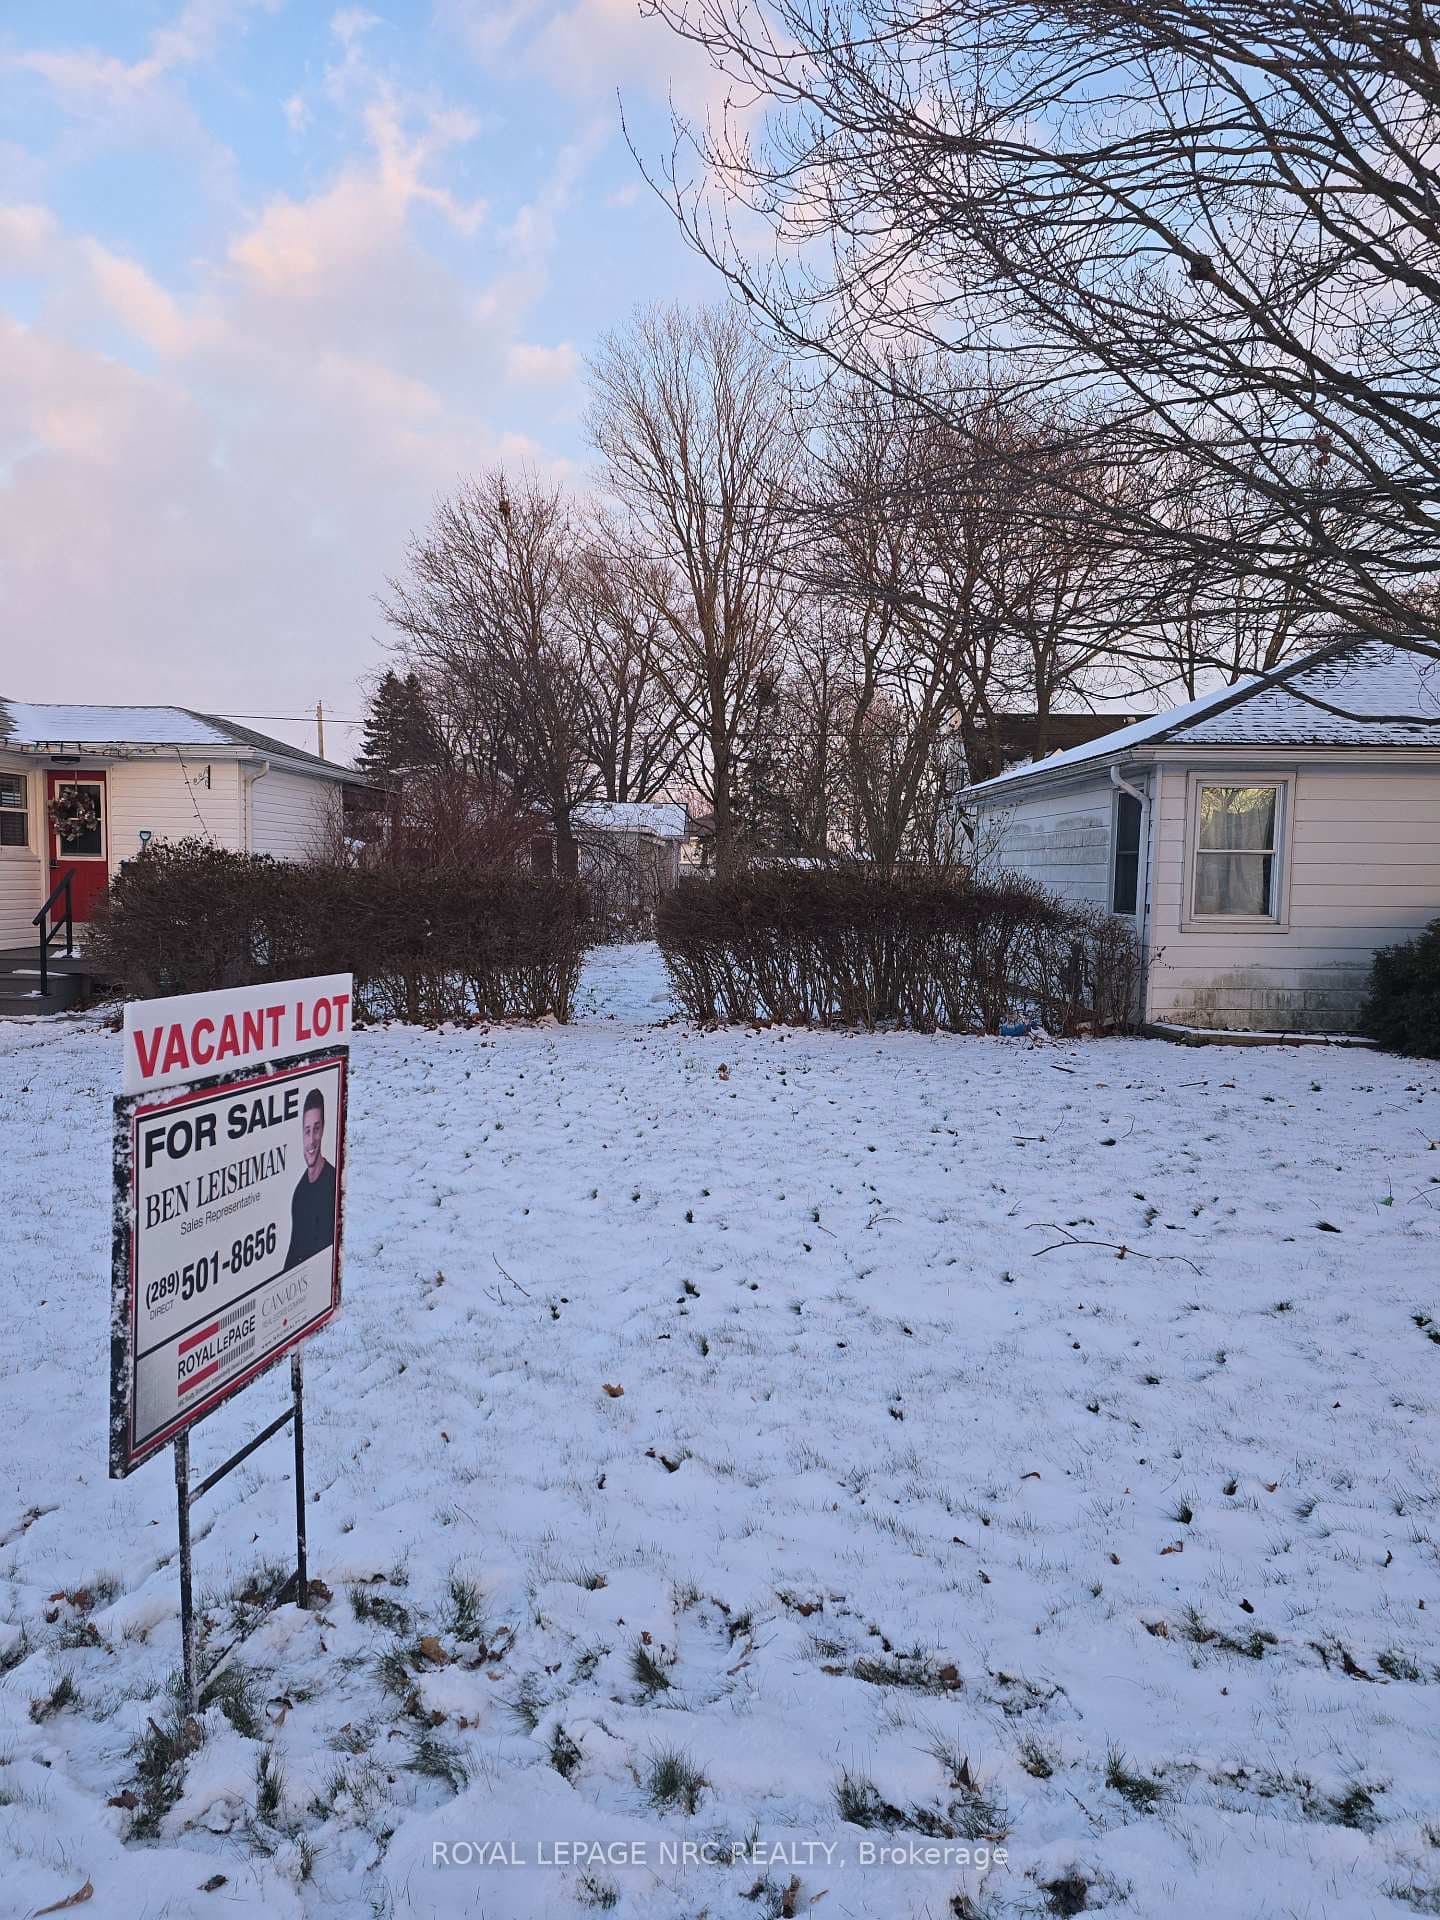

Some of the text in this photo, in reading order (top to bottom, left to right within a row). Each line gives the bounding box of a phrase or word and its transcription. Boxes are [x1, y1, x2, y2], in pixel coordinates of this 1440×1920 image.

[133, 994, 350, 1079] VACANT LOT
[144, 1087, 299, 1169] FOR SALE
[144, 1143, 288, 1230] BEN LEISHMAN
[180, 1191, 261, 1236] Sales Representative
[146, 1222, 276, 1310] (289) 501-8656
[149, 1299, 175, 1321] DIRECT
[177, 1341, 216, 1380] ROYAL
